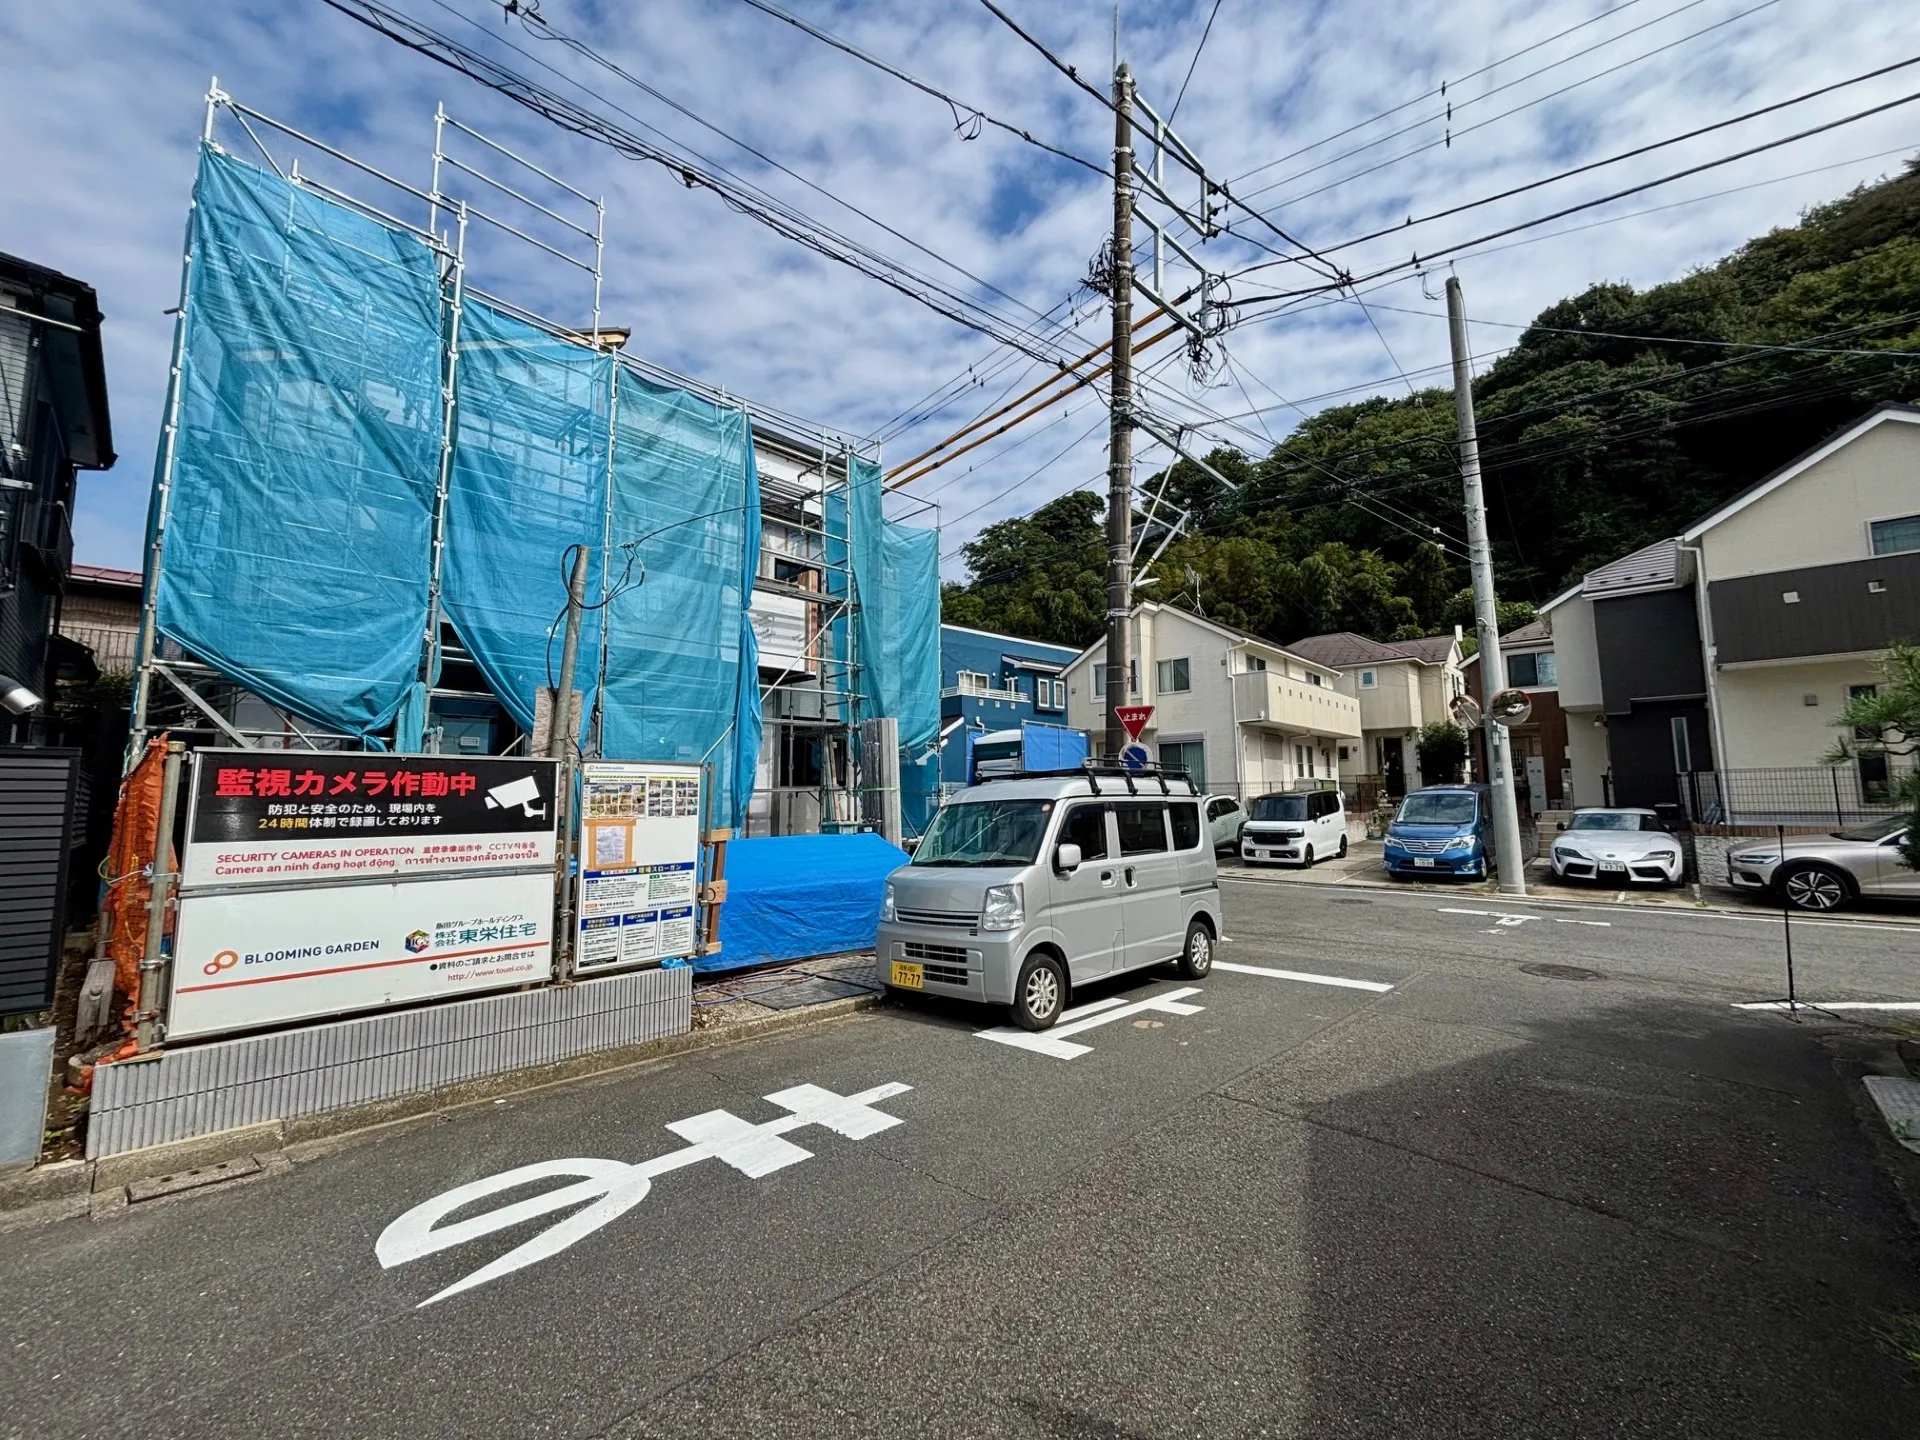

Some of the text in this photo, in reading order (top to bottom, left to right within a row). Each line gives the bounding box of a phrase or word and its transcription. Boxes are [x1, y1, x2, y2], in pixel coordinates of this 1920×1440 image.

[1123, 713, 1146, 721] 止まれ
[215, 768, 476, 797] 監視カメラ作動中
[267, 803, 437, 816] 防犯と安全のため、現場内を
[258, 815, 443, 829] 24時間体制で録画しております
[217, 846, 415, 864] SECURITY CAMERAS IN OPERATION
[215, 858, 396, 875] Camera an ninh đang hoạt động
[458, 922, 537, 944] 東栄住宅
[244, 940, 380, 965] BLOOMING GARDEN
[898, 971, 920, 986] 77-77
